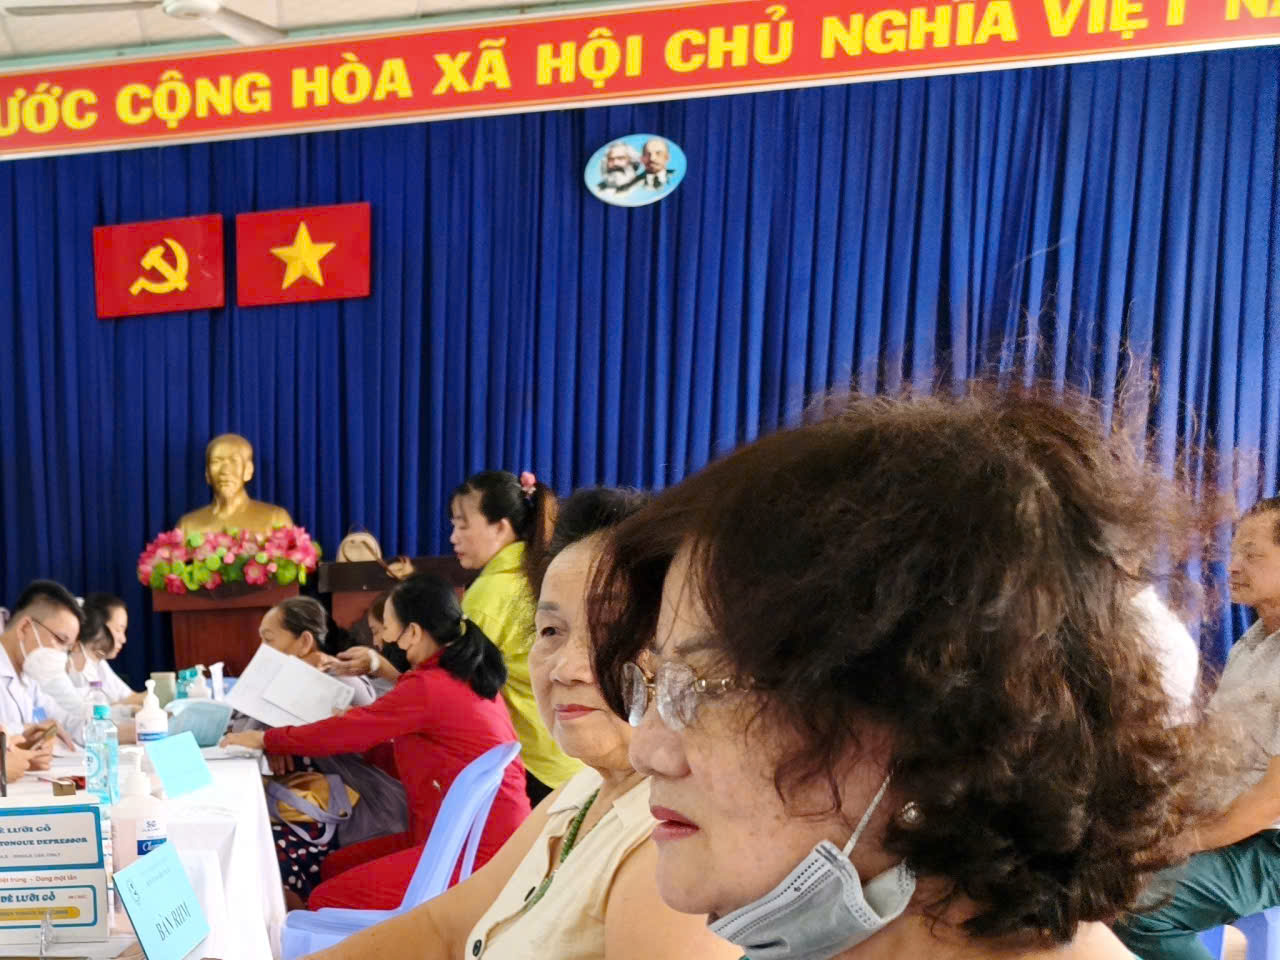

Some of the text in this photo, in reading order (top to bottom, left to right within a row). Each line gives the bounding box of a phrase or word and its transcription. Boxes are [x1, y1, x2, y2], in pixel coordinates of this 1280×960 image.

[115, 70, 272, 129] CỘNG
[291, 51, 413, 109] HÒA
[433, 37, 512, 95] XÃ
[537, 26, 642, 89] HỘI
[664, 4, 794, 73] CHỦ
[37, 837, 88, 846] DEPRESSOR
